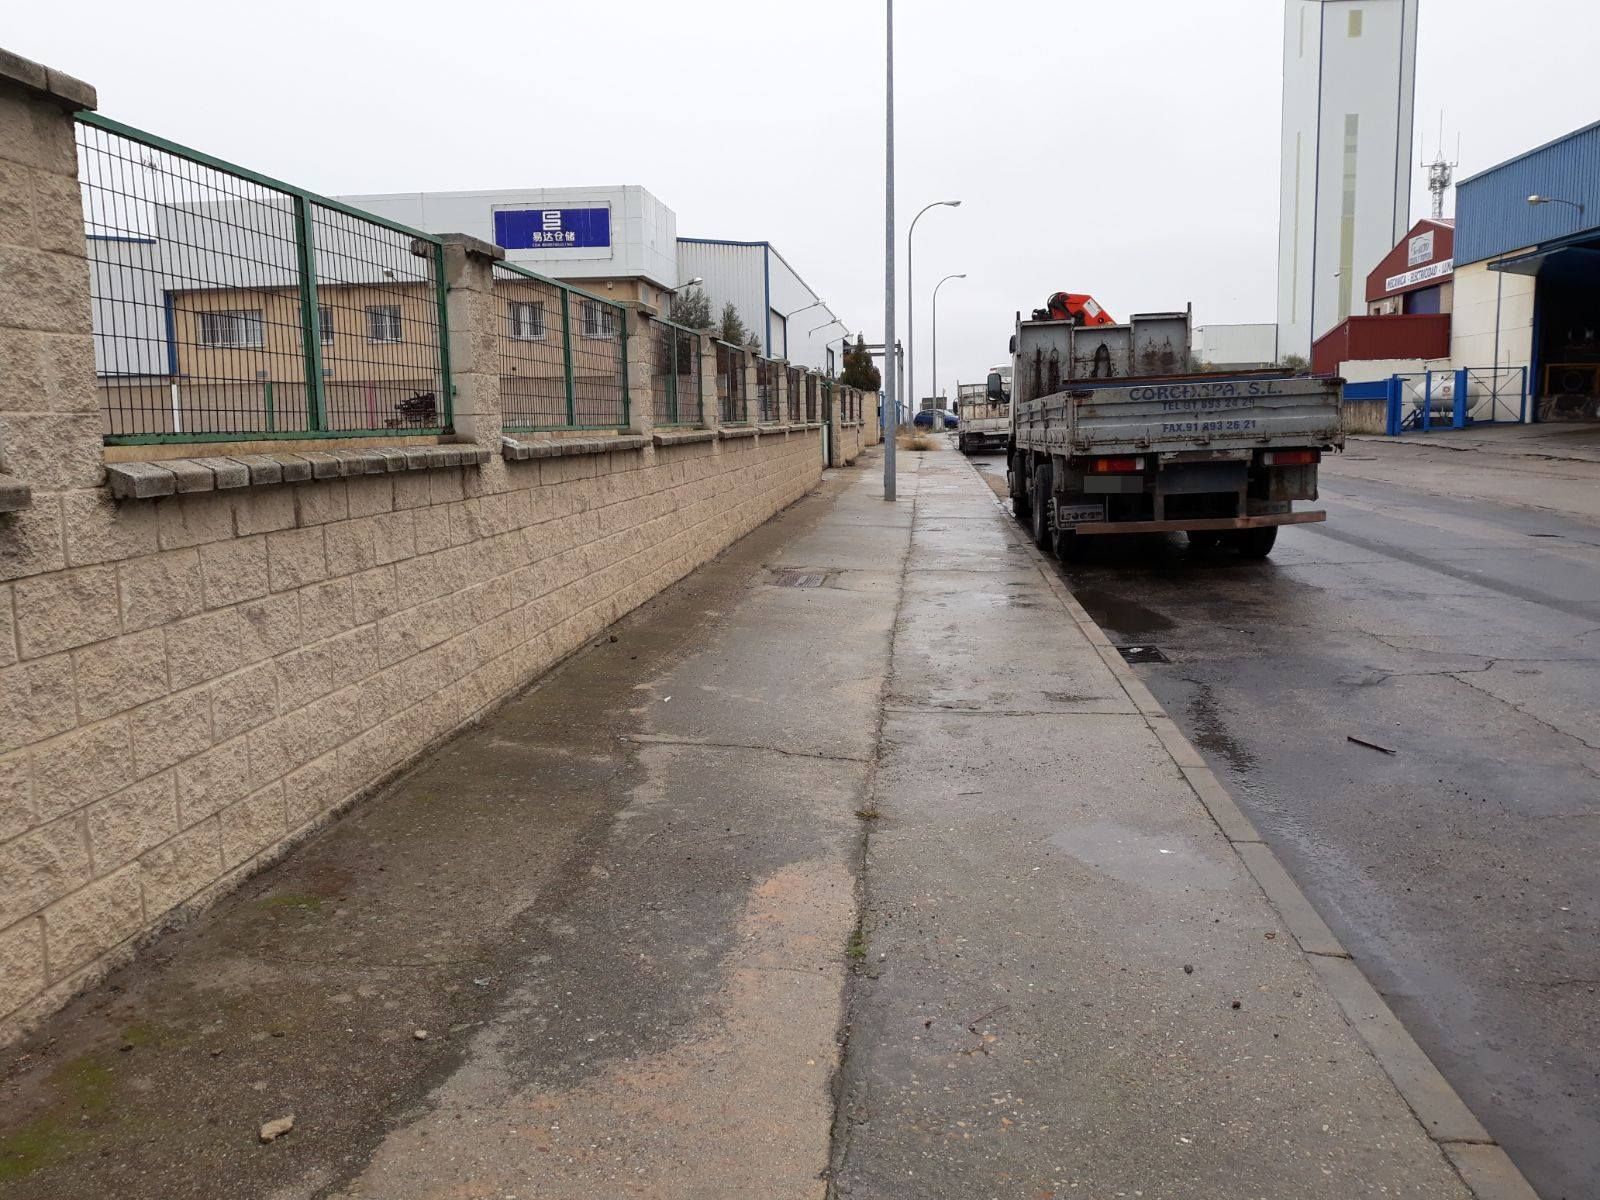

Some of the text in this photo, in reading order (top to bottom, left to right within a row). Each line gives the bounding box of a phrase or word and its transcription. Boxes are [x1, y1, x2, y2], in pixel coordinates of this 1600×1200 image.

[532, 231, 576, 242] 易达仓储
[1163, 401, 1180, 411] TEL
[1202, 421, 1223, 432] 893
[1244, 419, 1256, 429] 21
